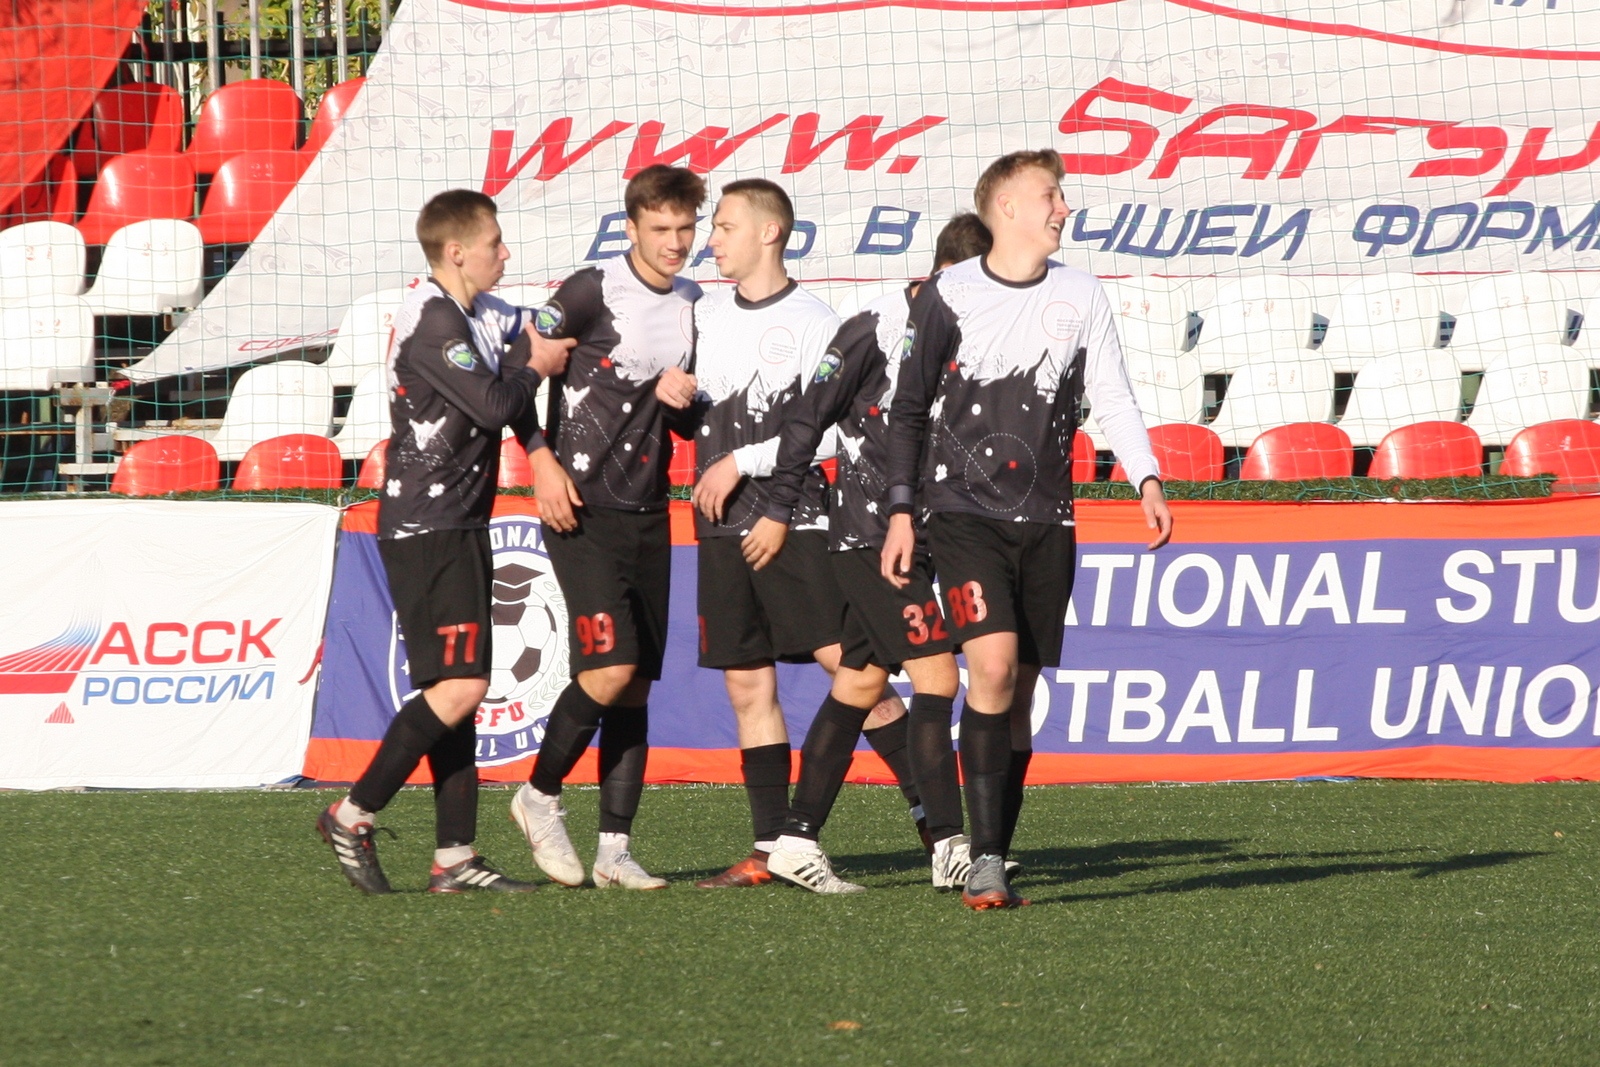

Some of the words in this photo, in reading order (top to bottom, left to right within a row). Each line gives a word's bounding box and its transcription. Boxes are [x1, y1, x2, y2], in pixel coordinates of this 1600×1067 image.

[1352, 201, 1600, 257] ФОРМ
[932, 550, 1406, 627] TIONAL
[947, 581, 987, 628] 88
[89, 617, 283, 665] АССК
[437, 622, 479, 666] 77
[576, 612, 615, 656] 99
[903, 604, 949, 645] 32
[82, 671, 275, 705] РОССИИ
[1371, 664, 1600, 739] UNIO
